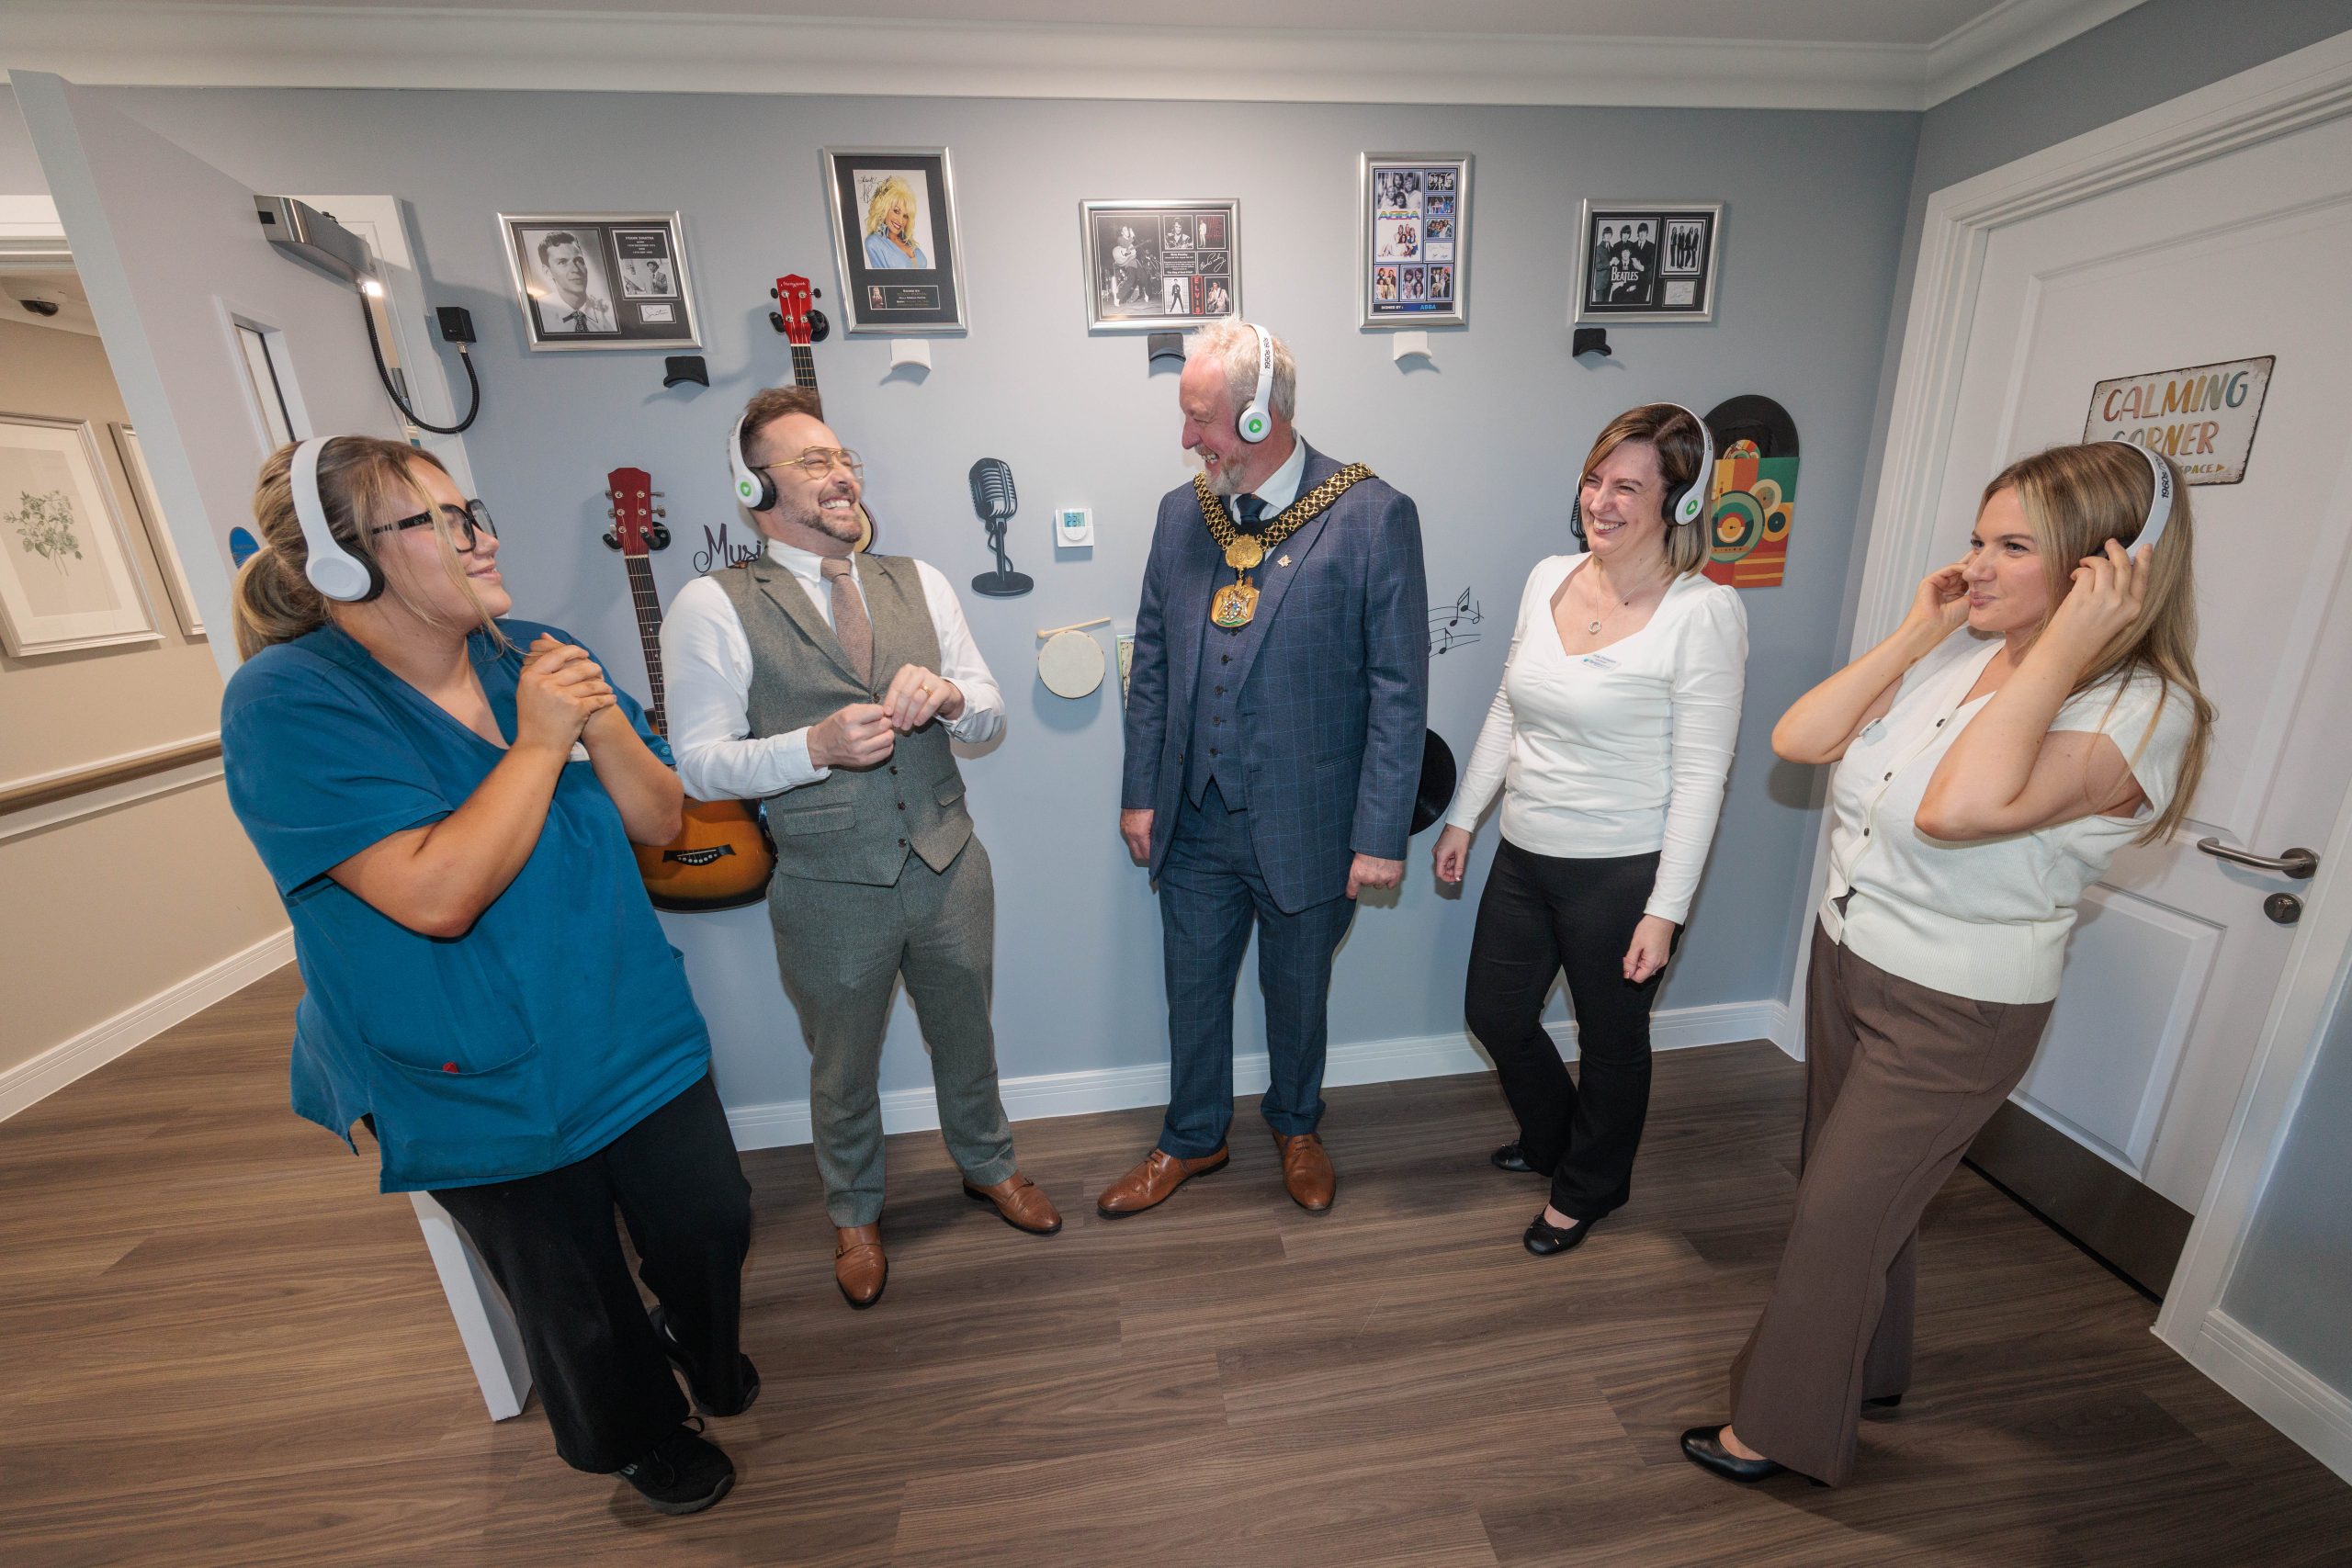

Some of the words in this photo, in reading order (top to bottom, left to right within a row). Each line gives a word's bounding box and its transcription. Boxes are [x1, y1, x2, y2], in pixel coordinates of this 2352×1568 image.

[1377, 210, 1420, 220] ABBA
[1611, 266, 1639, 283] BEATLES
[2103, 370, 2249, 422] CALMING
[693, 523, 768, 574] Musi
